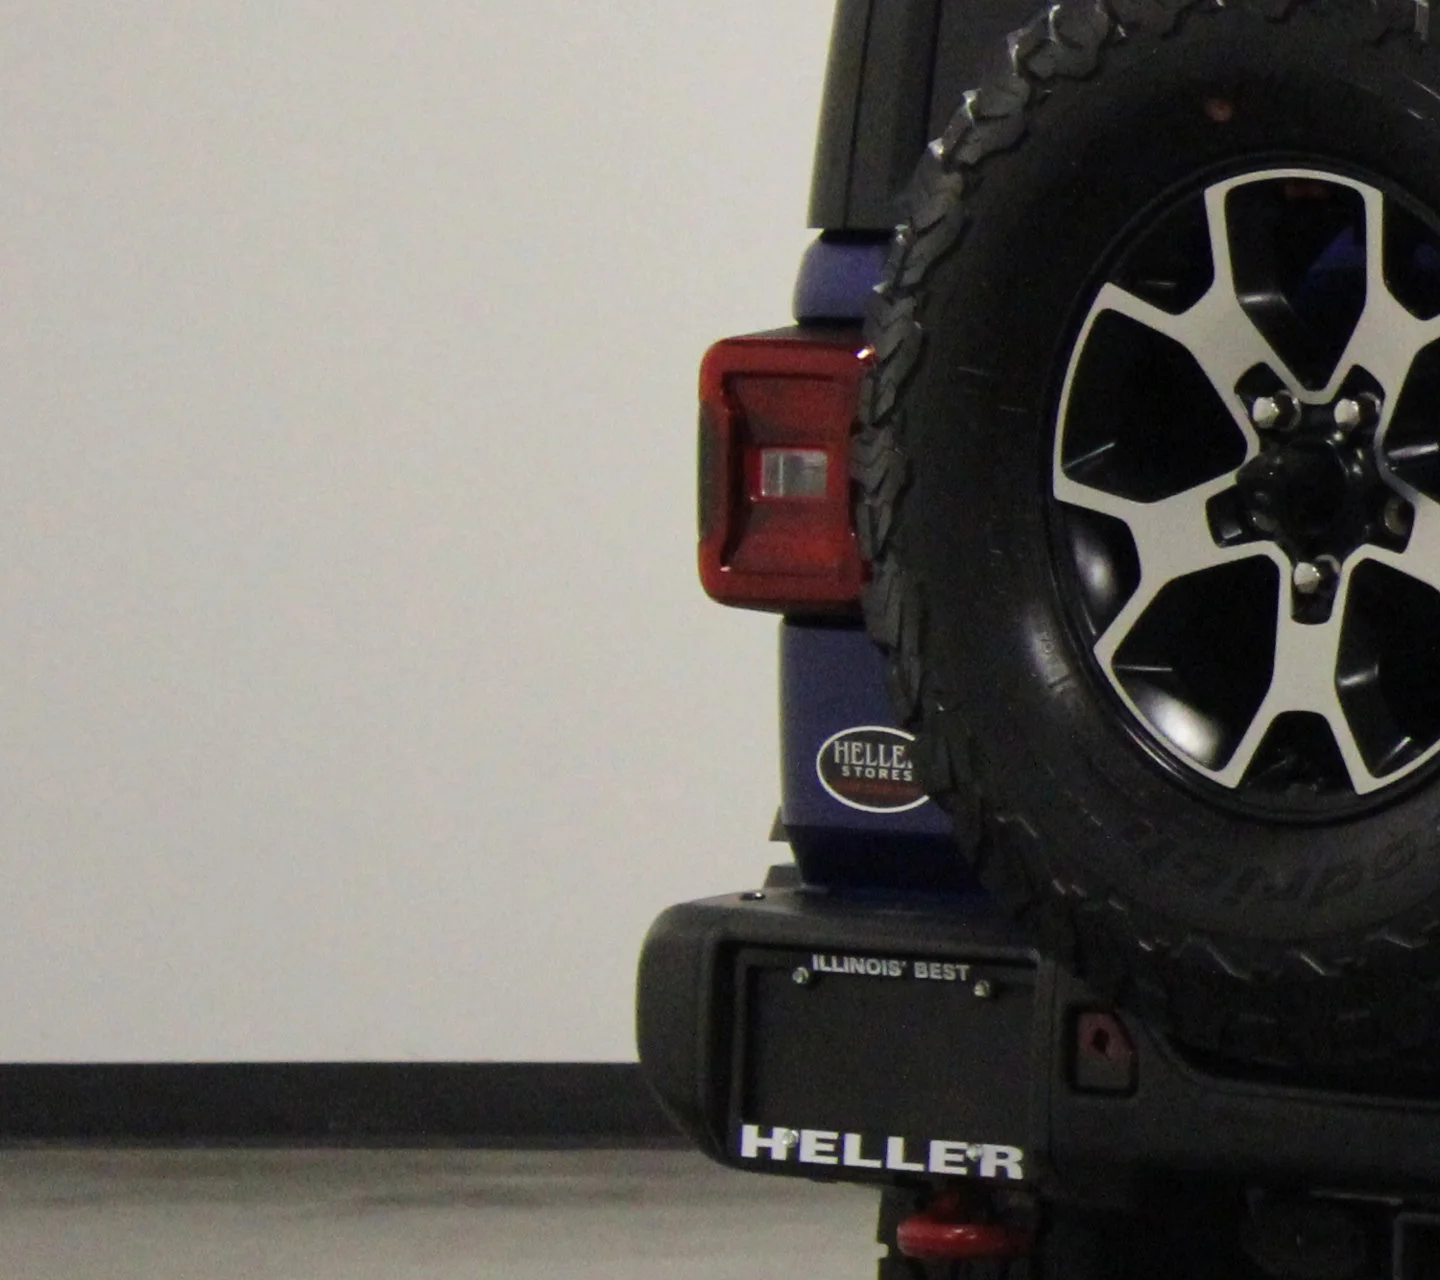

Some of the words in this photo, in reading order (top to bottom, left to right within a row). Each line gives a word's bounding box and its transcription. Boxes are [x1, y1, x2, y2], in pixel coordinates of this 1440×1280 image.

[833, 741, 913, 769] HELLE
[841, 765, 913, 782] STORES
[914, 962, 970, 981] BEST
[740, 1124, 1024, 1180] HELLER
